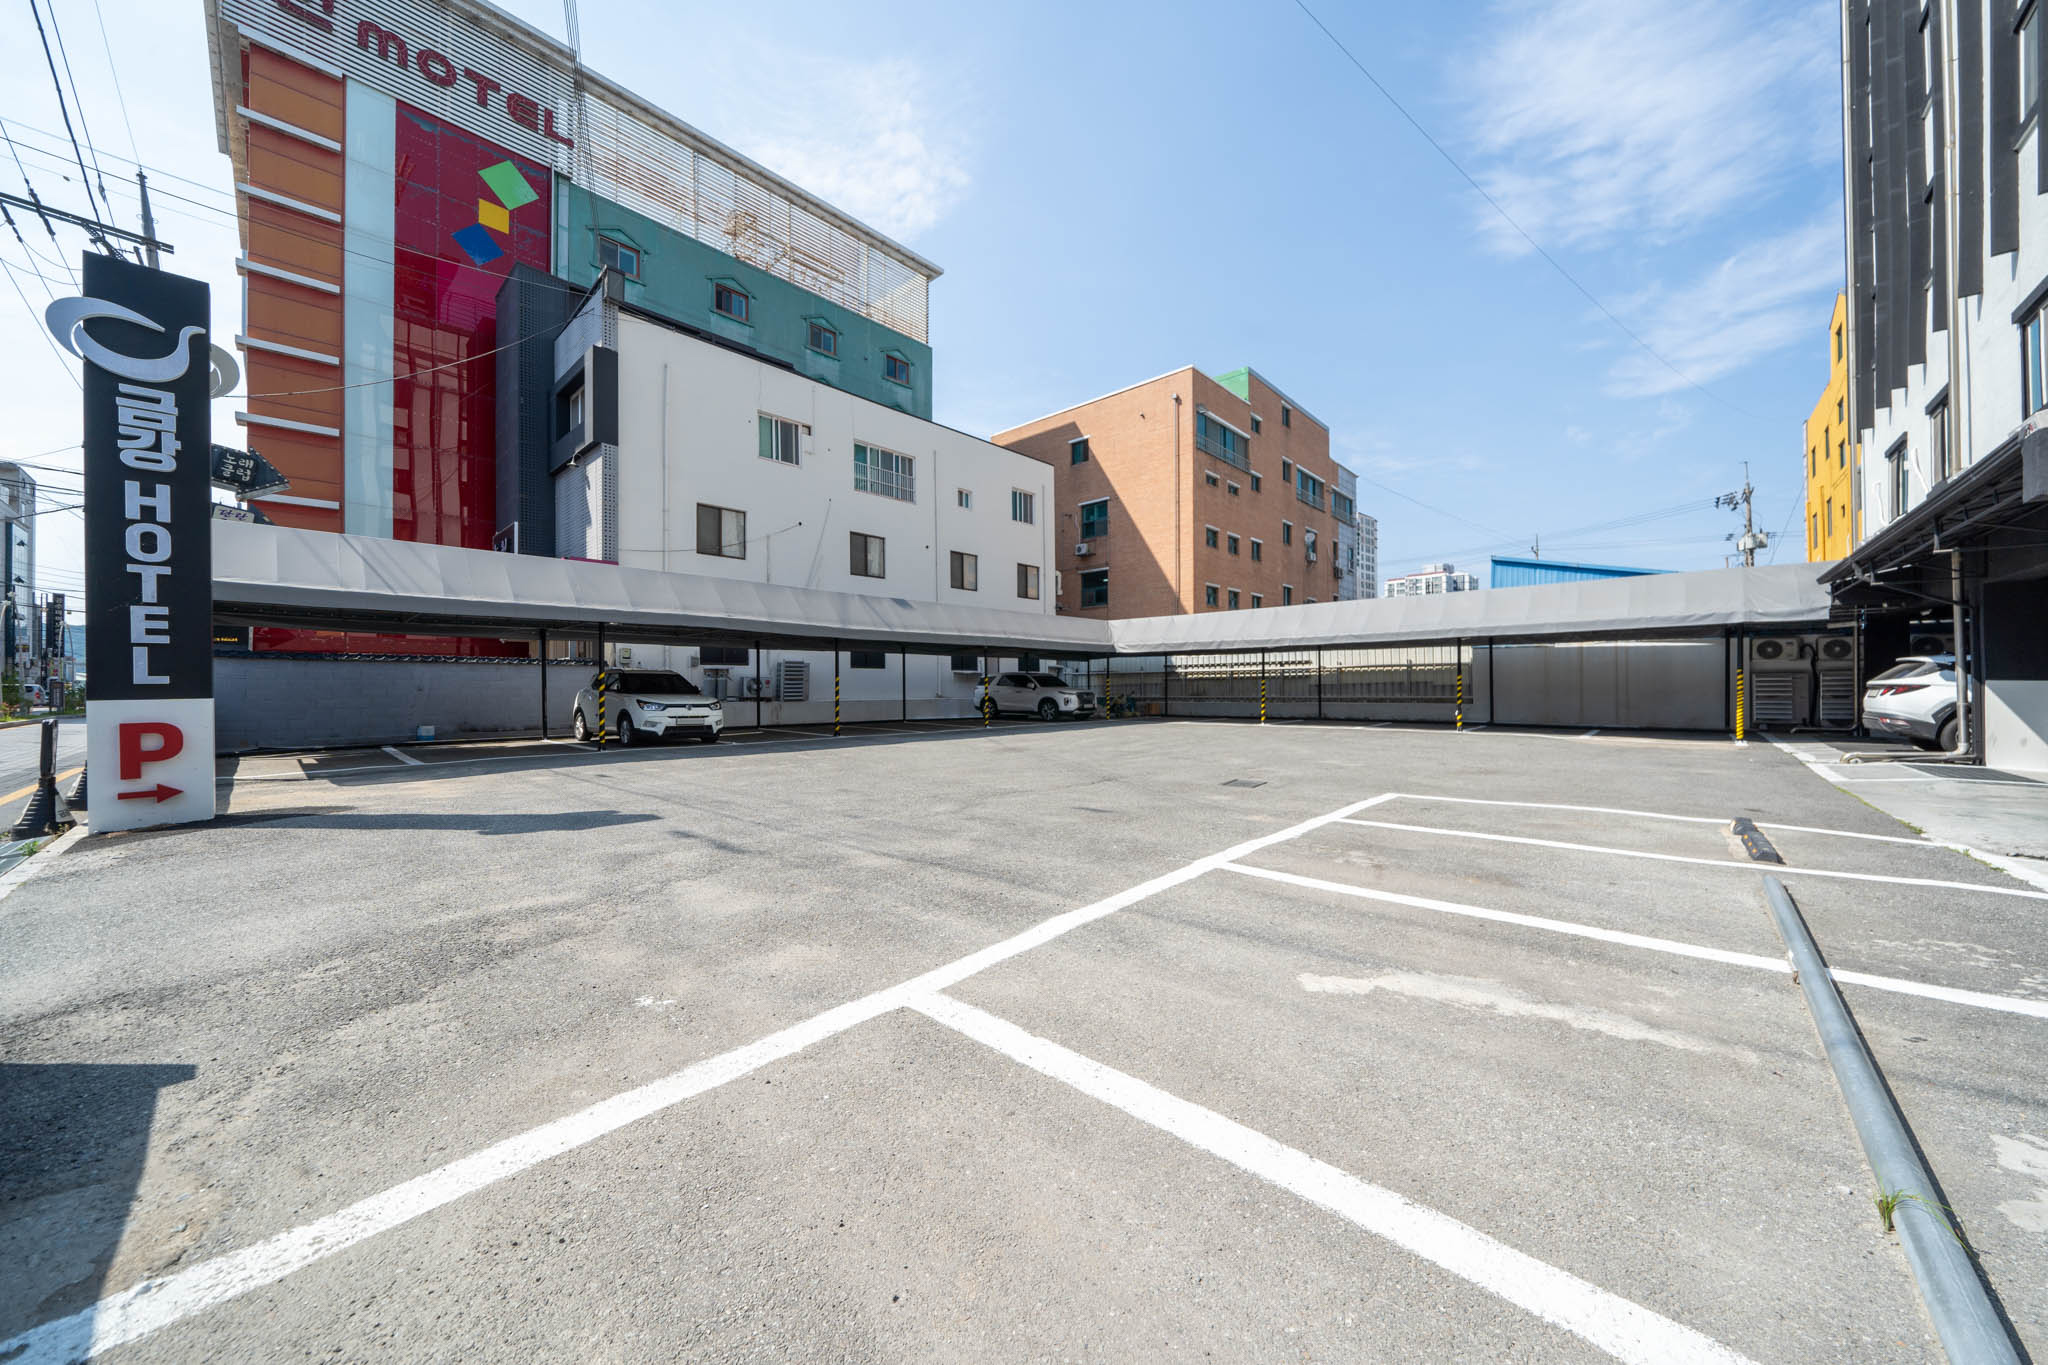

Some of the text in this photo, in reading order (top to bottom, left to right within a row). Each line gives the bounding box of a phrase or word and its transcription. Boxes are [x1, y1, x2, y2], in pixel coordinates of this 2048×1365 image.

[223, 453, 254, 468] 노래
[116, 383, 181, 685] 금강 HOTEL
[119, 722, 184, 780] P
